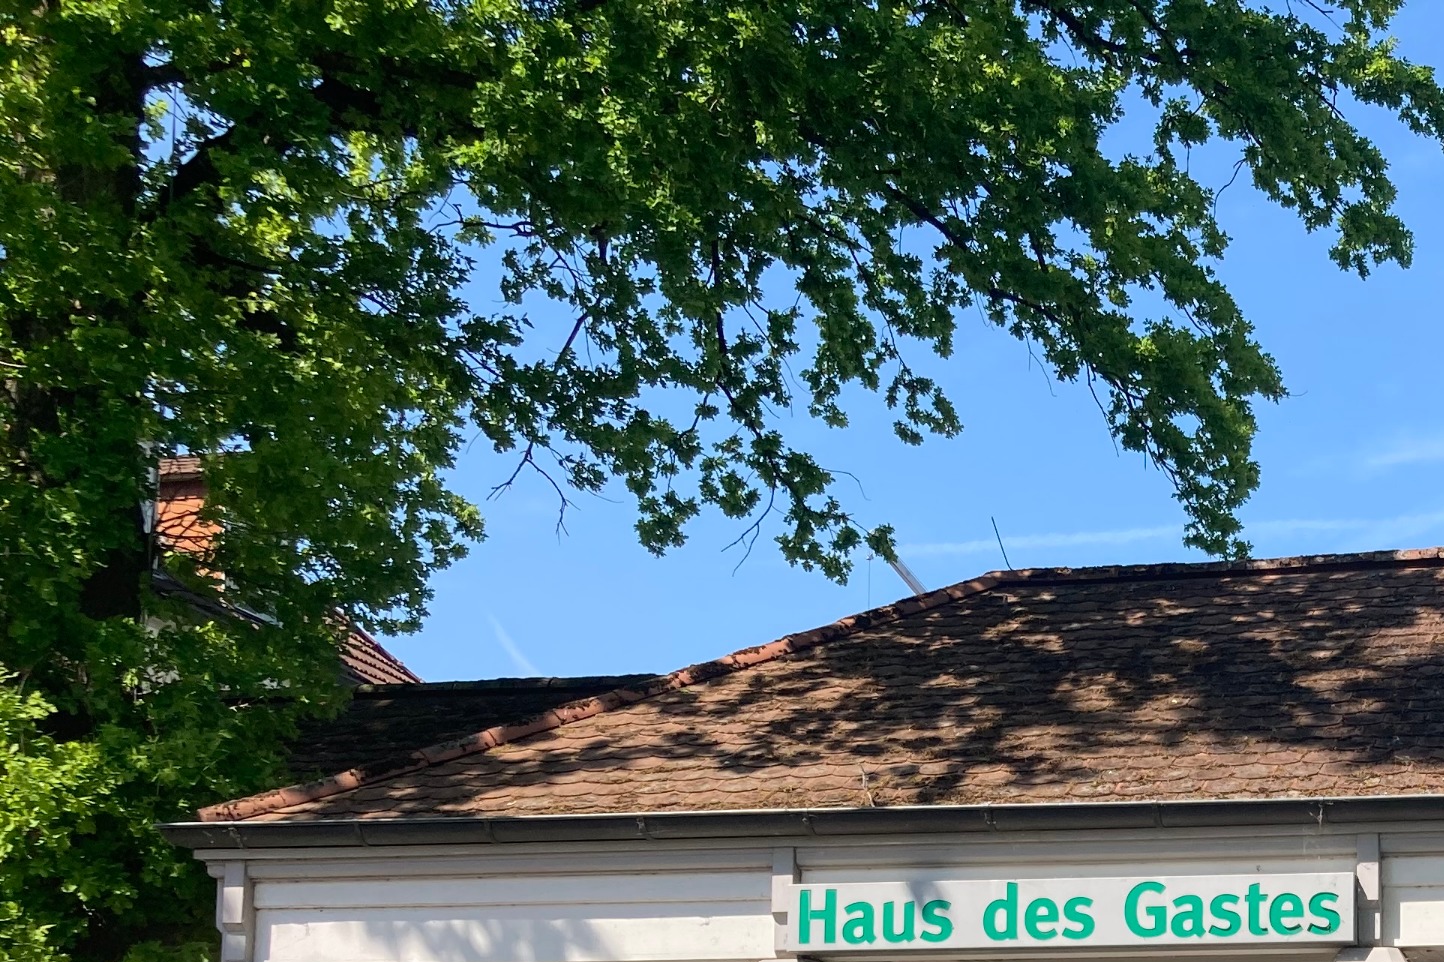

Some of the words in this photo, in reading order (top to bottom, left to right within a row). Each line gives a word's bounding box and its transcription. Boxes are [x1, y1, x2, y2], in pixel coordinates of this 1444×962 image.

[798, 888, 954, 944] Haus
[983, 881, 1096, 941] des
[1124, 881, 1341, 938] Gastes
